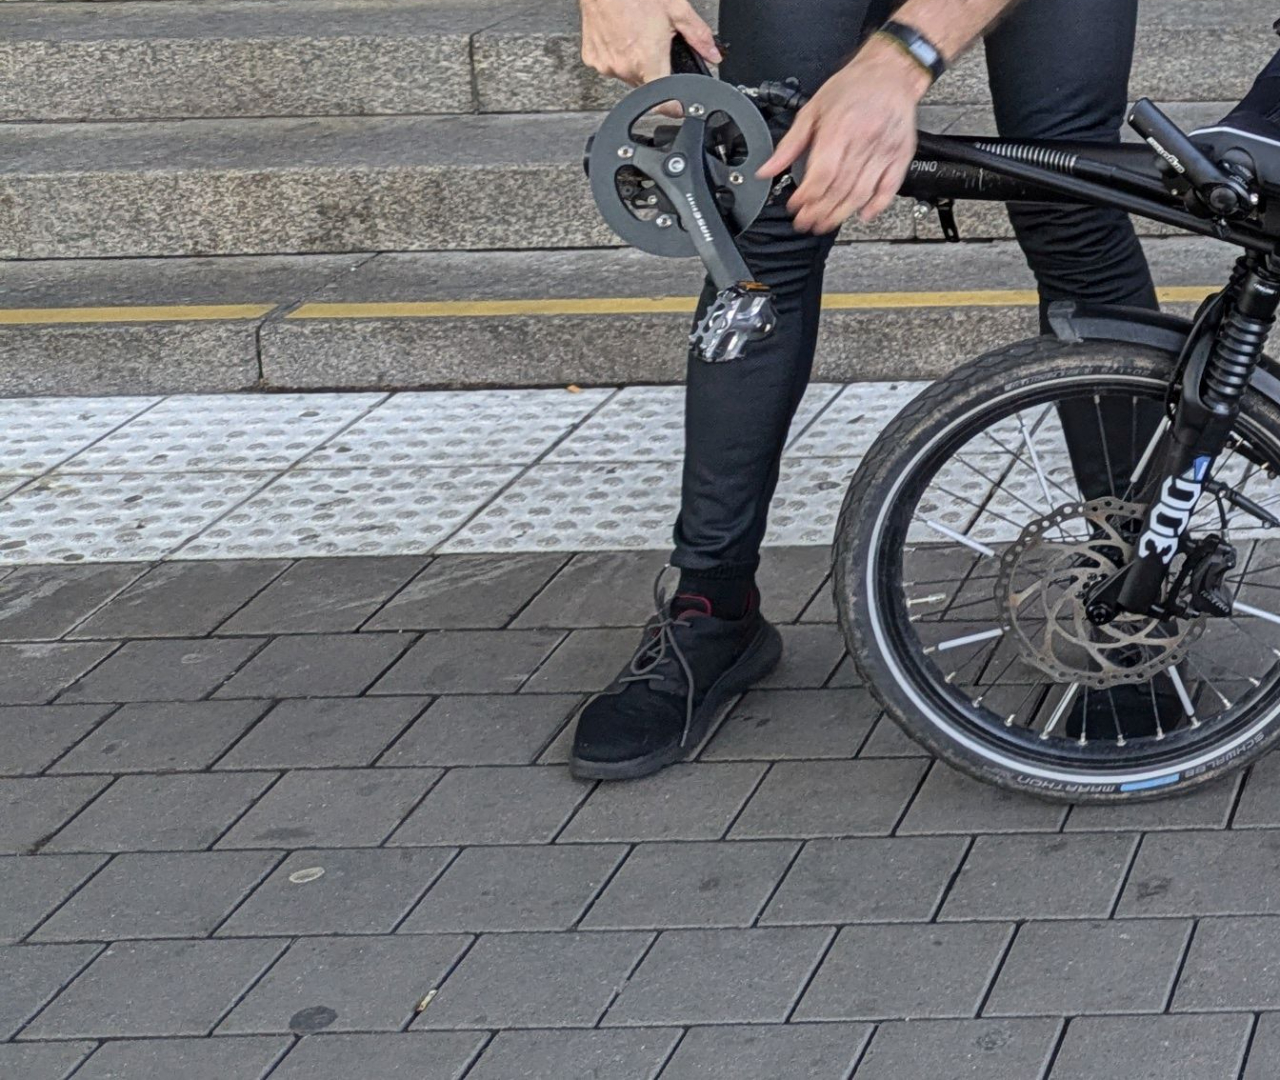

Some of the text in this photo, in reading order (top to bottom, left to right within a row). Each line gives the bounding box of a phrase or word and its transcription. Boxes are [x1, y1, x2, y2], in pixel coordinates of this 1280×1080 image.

[1138, 474, 1202, 565] 300
[1184, 731, 1265, 778] SCHWALBE
[1017, 775, 1116, 793] MARATHON
